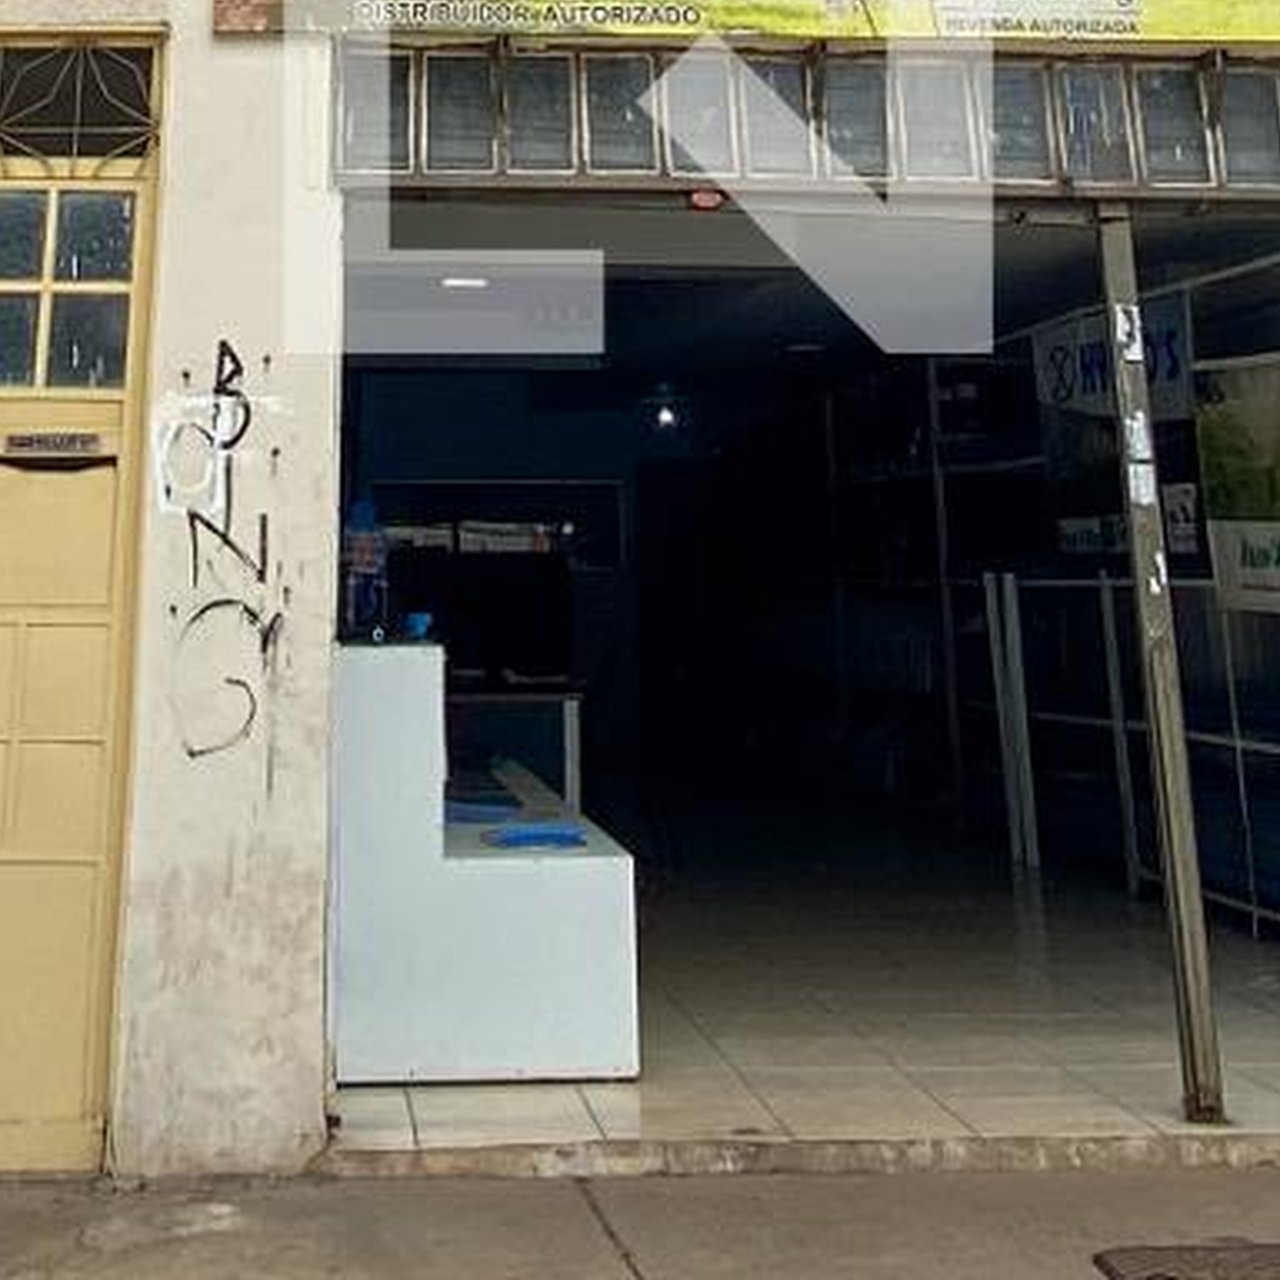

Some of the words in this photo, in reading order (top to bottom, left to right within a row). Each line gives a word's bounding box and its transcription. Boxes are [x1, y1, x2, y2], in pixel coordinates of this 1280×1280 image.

[354, 1, 529, 24] DISTRIBUIDOR
[542, 3, 702, 26] AUTORIZADO
[1029, 18, 1140, 35] AUTORIZADA
